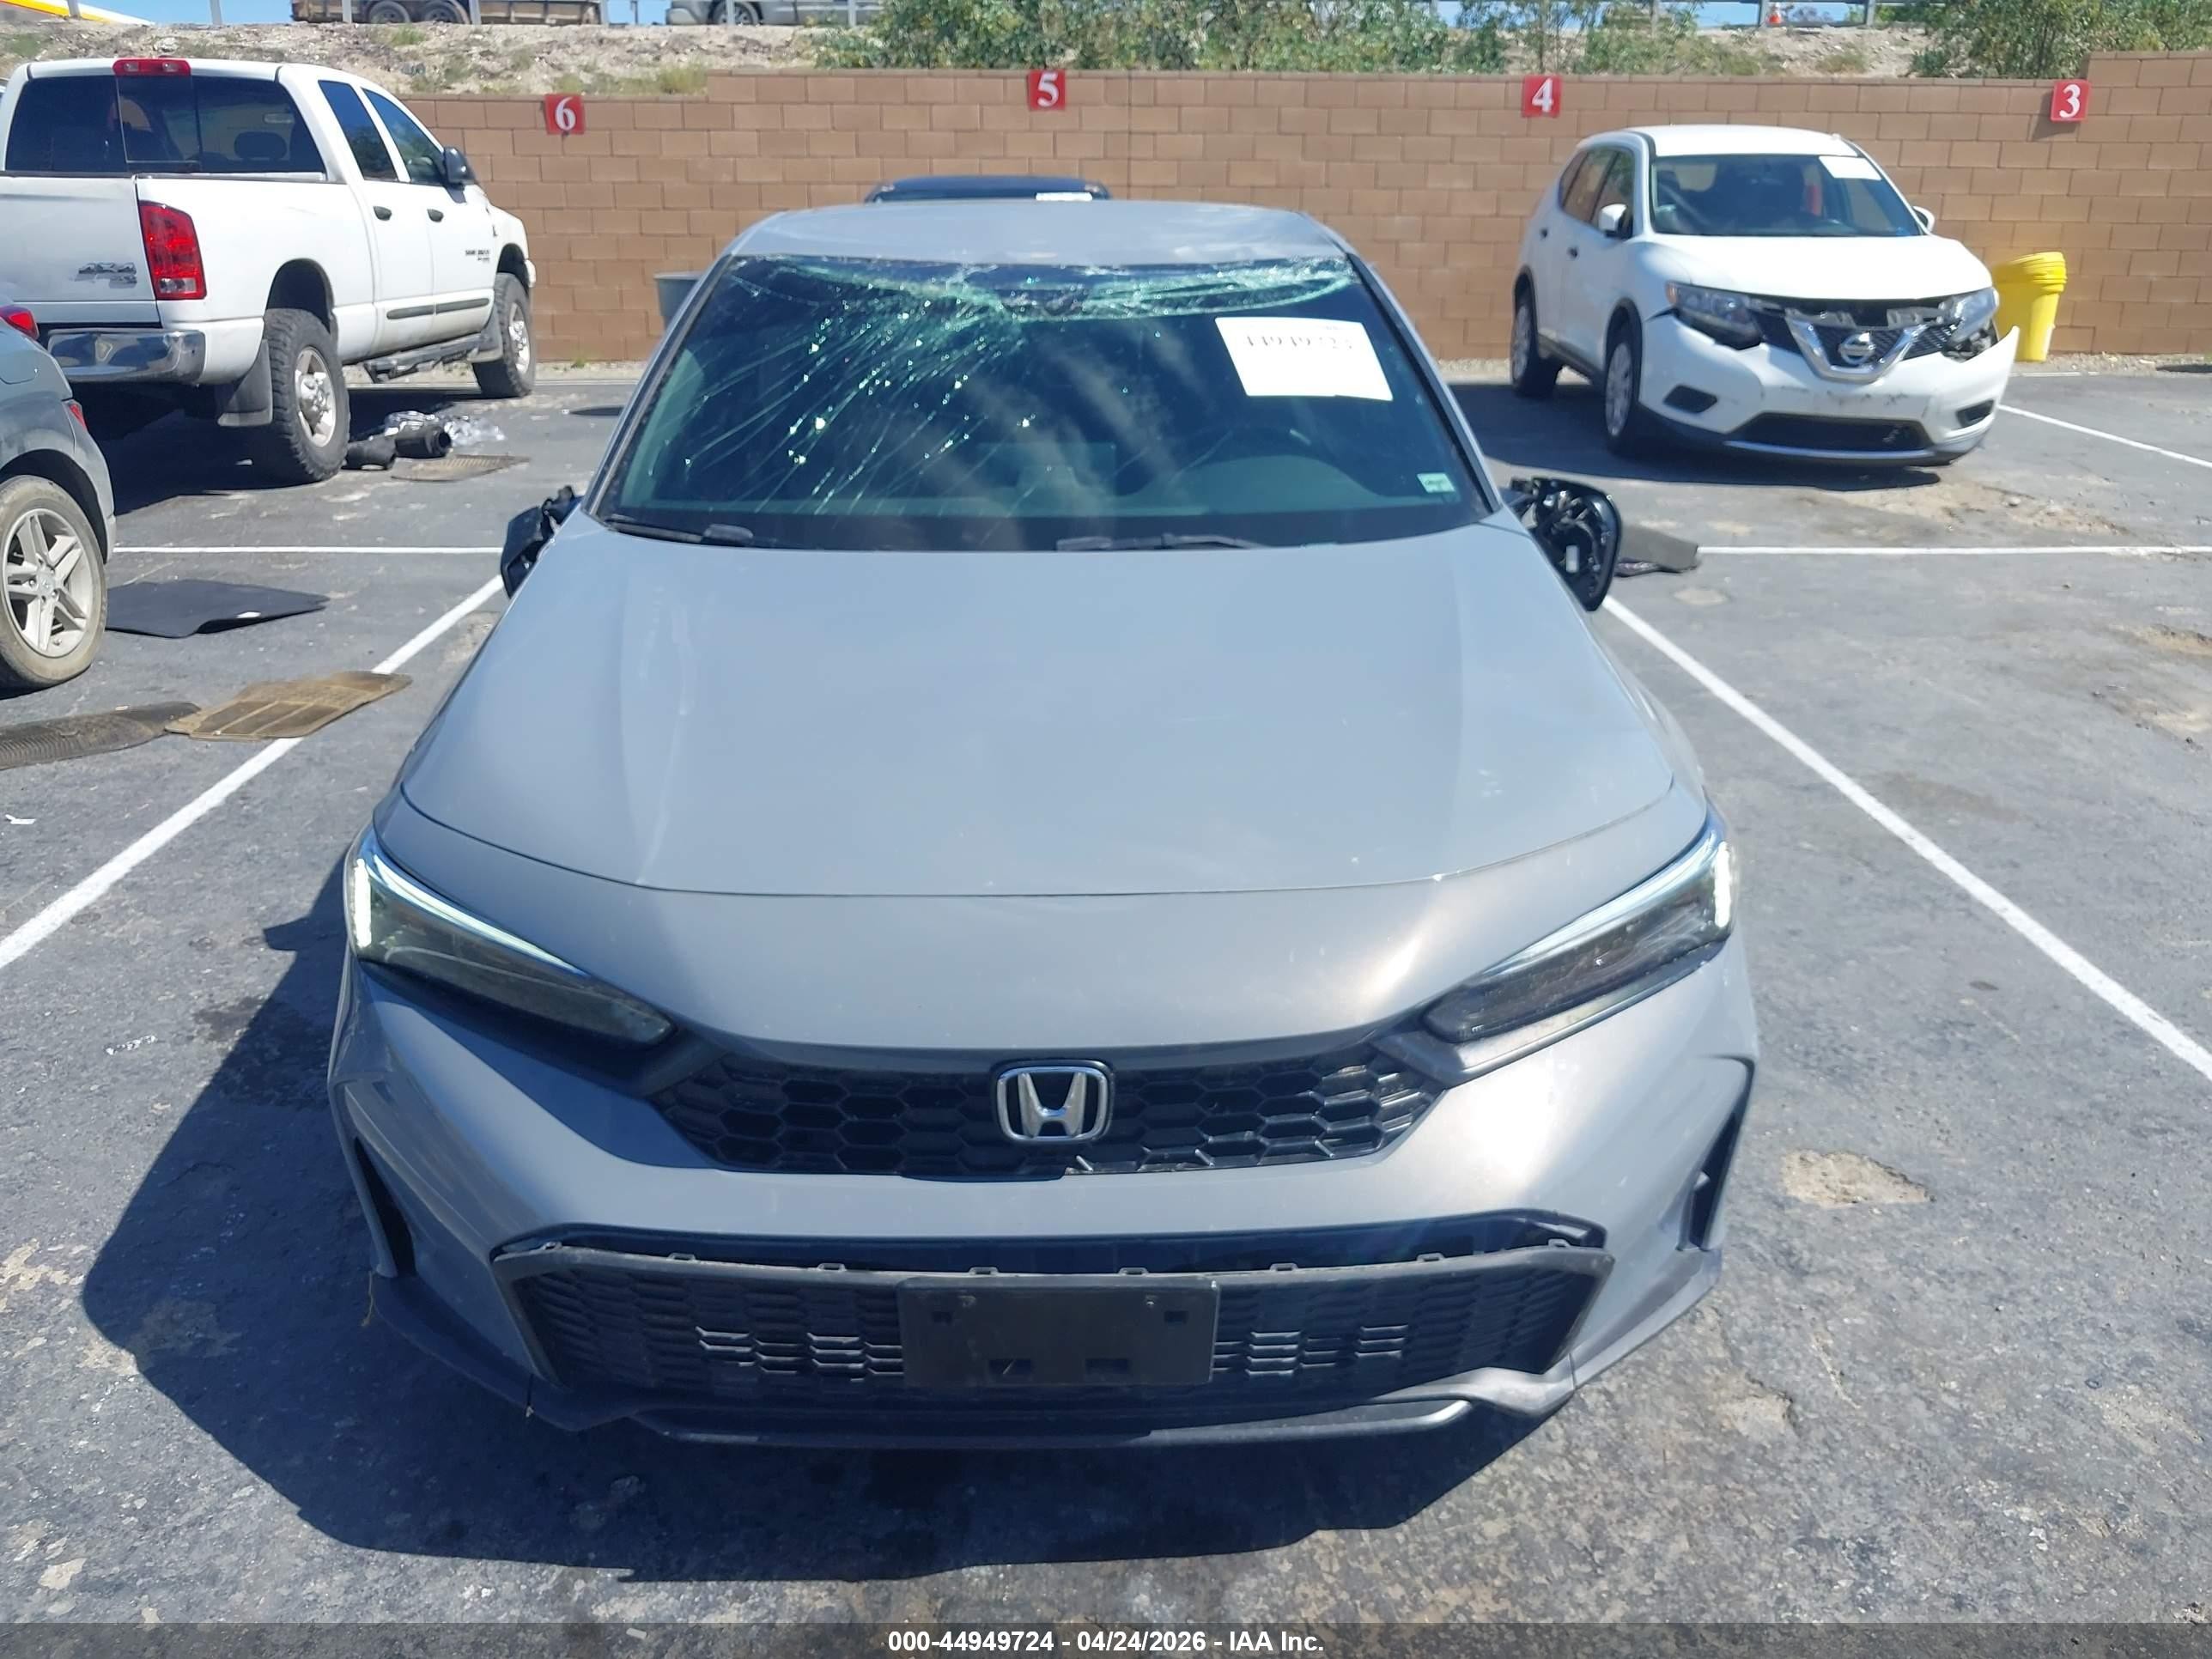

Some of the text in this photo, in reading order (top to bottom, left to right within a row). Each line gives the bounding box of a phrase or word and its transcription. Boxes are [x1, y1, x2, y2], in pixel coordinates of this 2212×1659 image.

[1037, 71, 1058, 106] 5
[1532, 77, 1553, 112] 4
[2058, 82, 2081, 118] 3
[554, 97, 576, 131] 6
